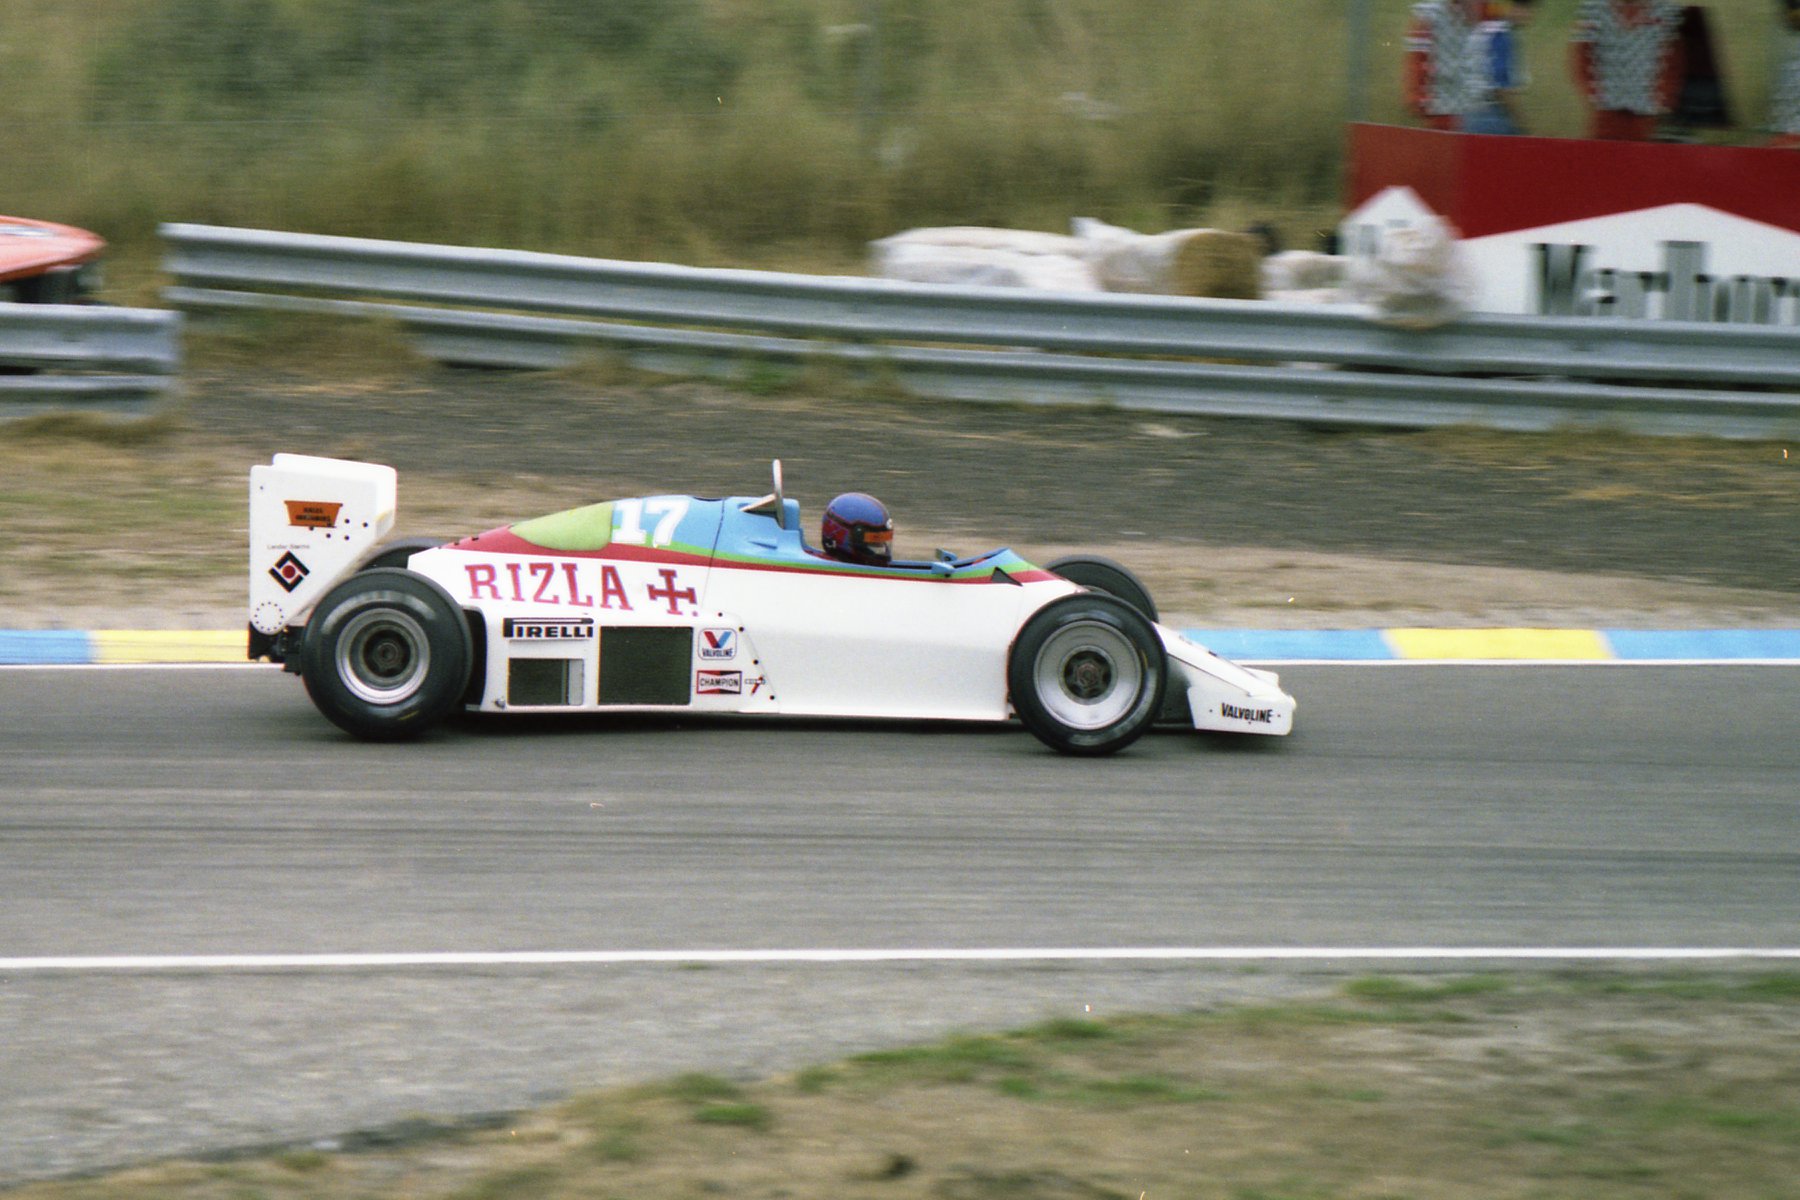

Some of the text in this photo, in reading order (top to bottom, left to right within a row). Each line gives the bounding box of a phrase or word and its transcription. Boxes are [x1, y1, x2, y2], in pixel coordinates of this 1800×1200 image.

[611, 499, 690, 548] 17
[465, 562, 634, 611] RIZLA
[503, 617, 594, 638] PIRELLI
[702, 647, 734, 657] VALVOLINE
[700, 677, 739, 687] CHAMPION
[1221, 703, 1273, 723] VALVOLINE
